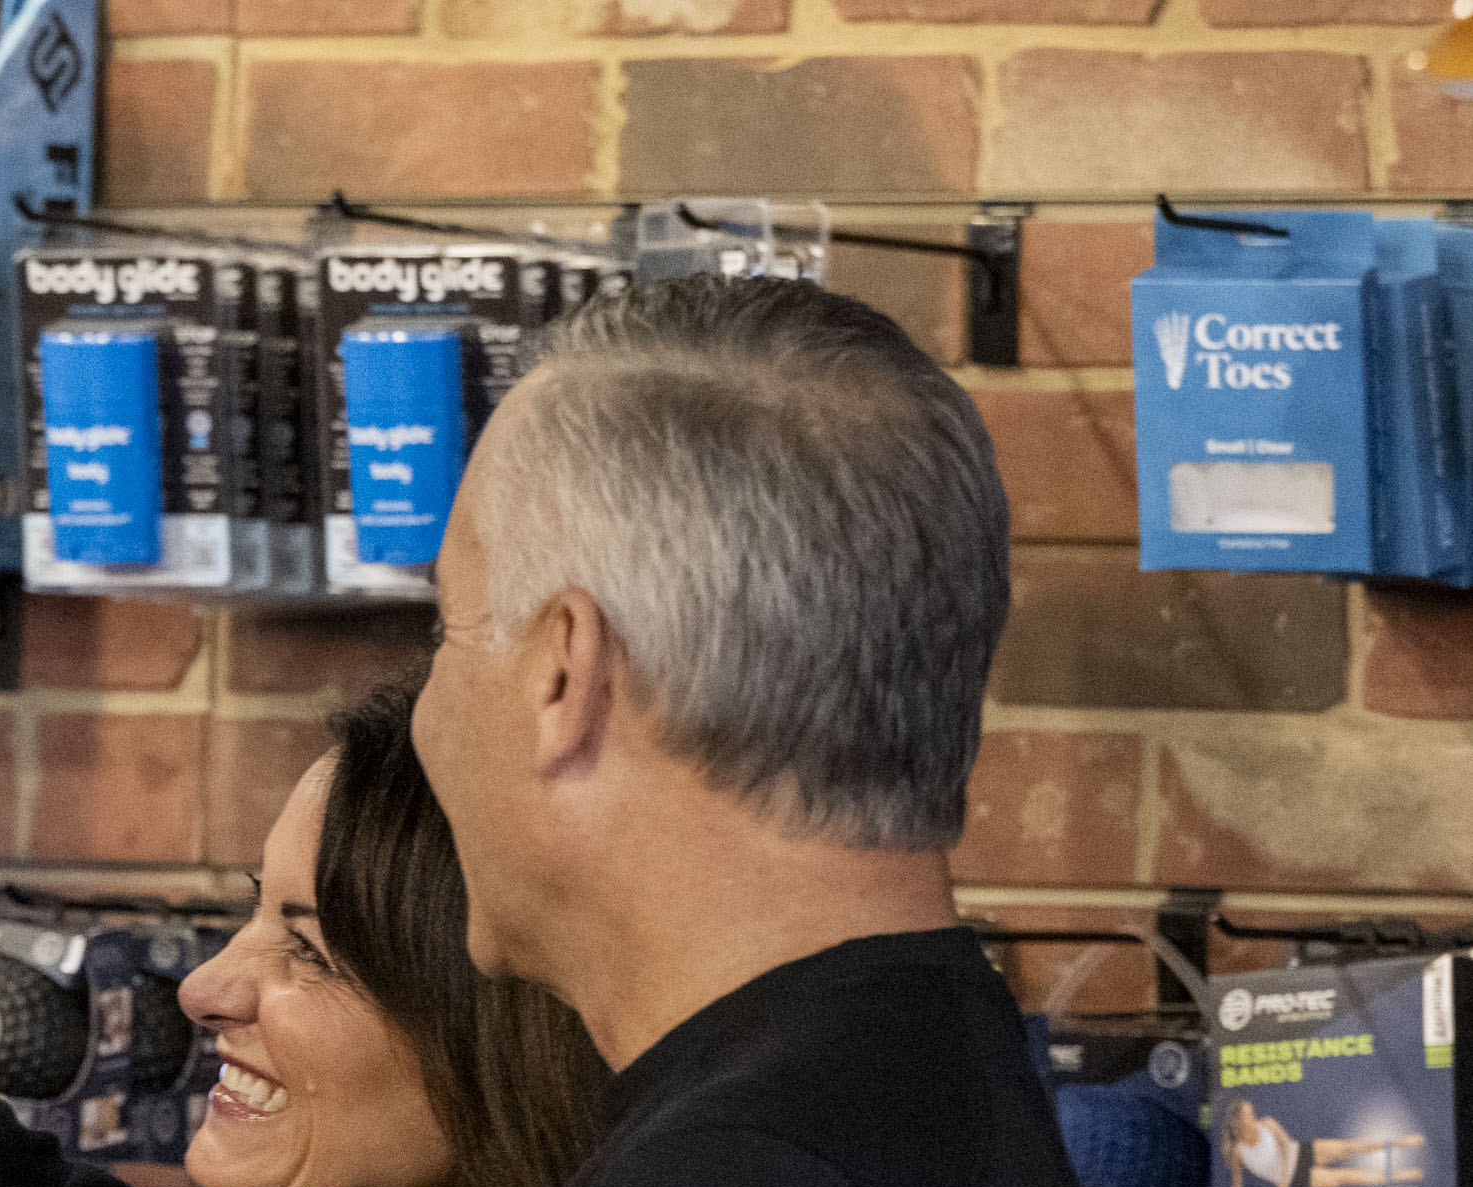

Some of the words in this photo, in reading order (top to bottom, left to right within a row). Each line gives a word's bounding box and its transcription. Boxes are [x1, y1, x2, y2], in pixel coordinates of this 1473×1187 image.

[28, 259, 116, 304] body
[117, 259, 199, 304] glide
[329, 256, 419, 302] body
[420, 257, 505, 302] glide
[1194, 312, 1342, 351] Correct
[1196, 351, 1292, 390] Toes
[1220, 1034, 1373, 1066] RESISTANCE
[1220, 1061, 1303, 1088] BANDS
